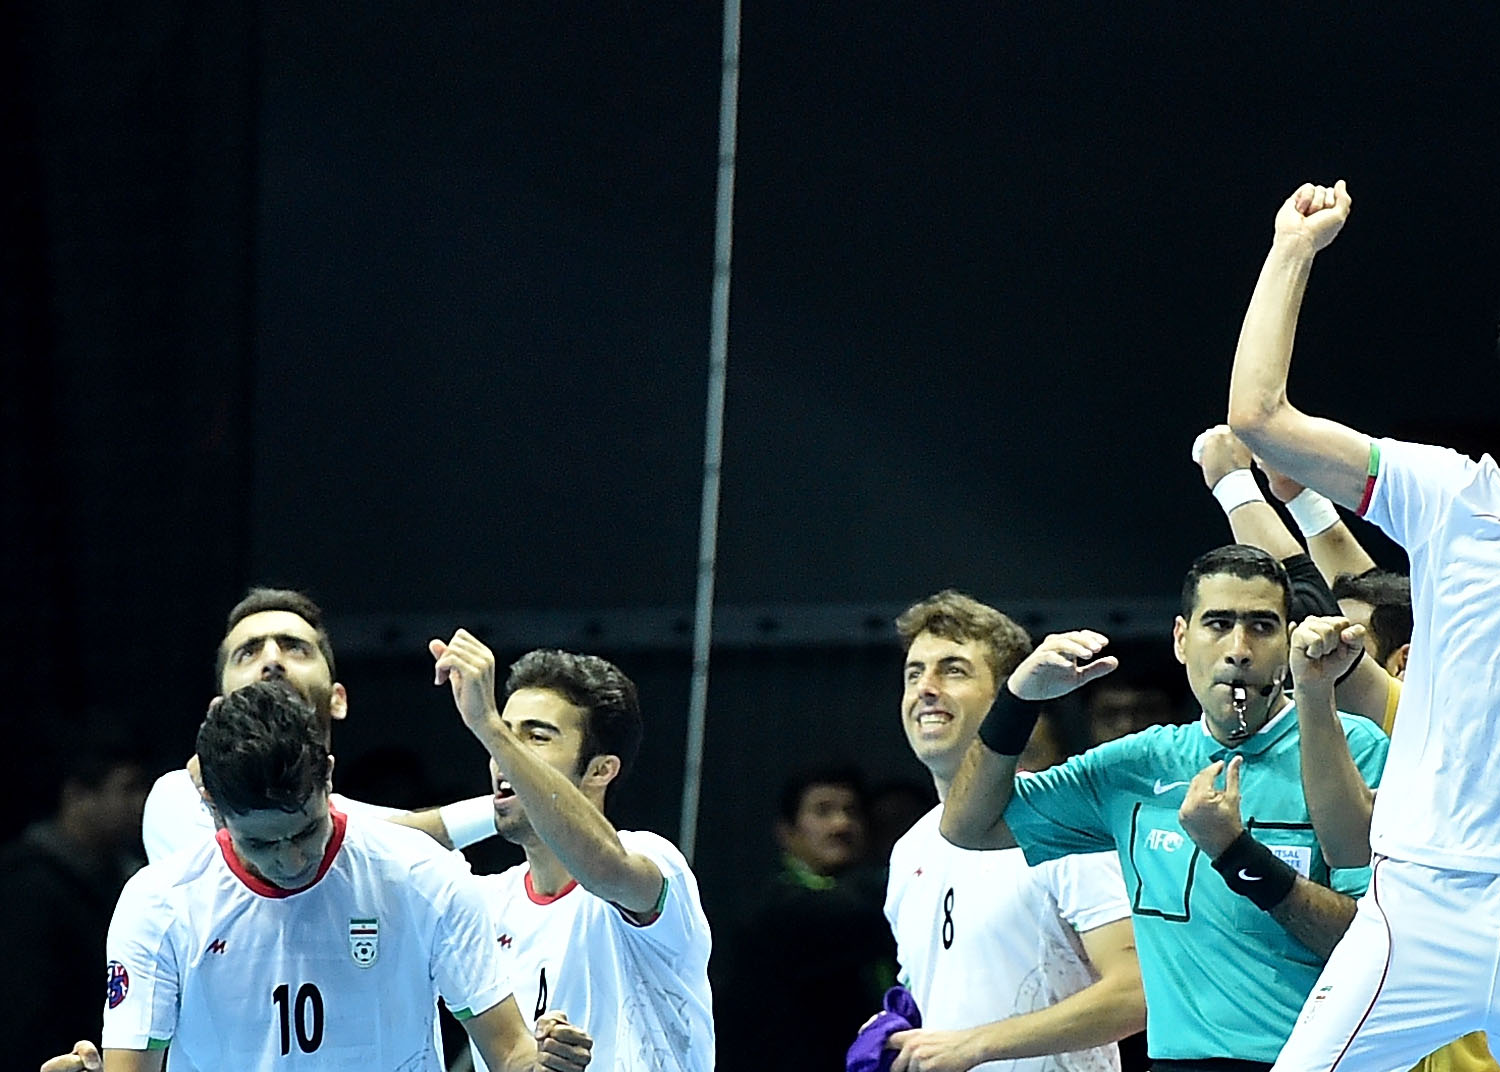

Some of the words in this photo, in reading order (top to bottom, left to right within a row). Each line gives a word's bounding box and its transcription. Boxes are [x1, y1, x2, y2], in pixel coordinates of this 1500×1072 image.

[942, 887, 955, 950] 8
[272, 982, 324, 1056] 10
[534, 967, 548, 1022] 4
